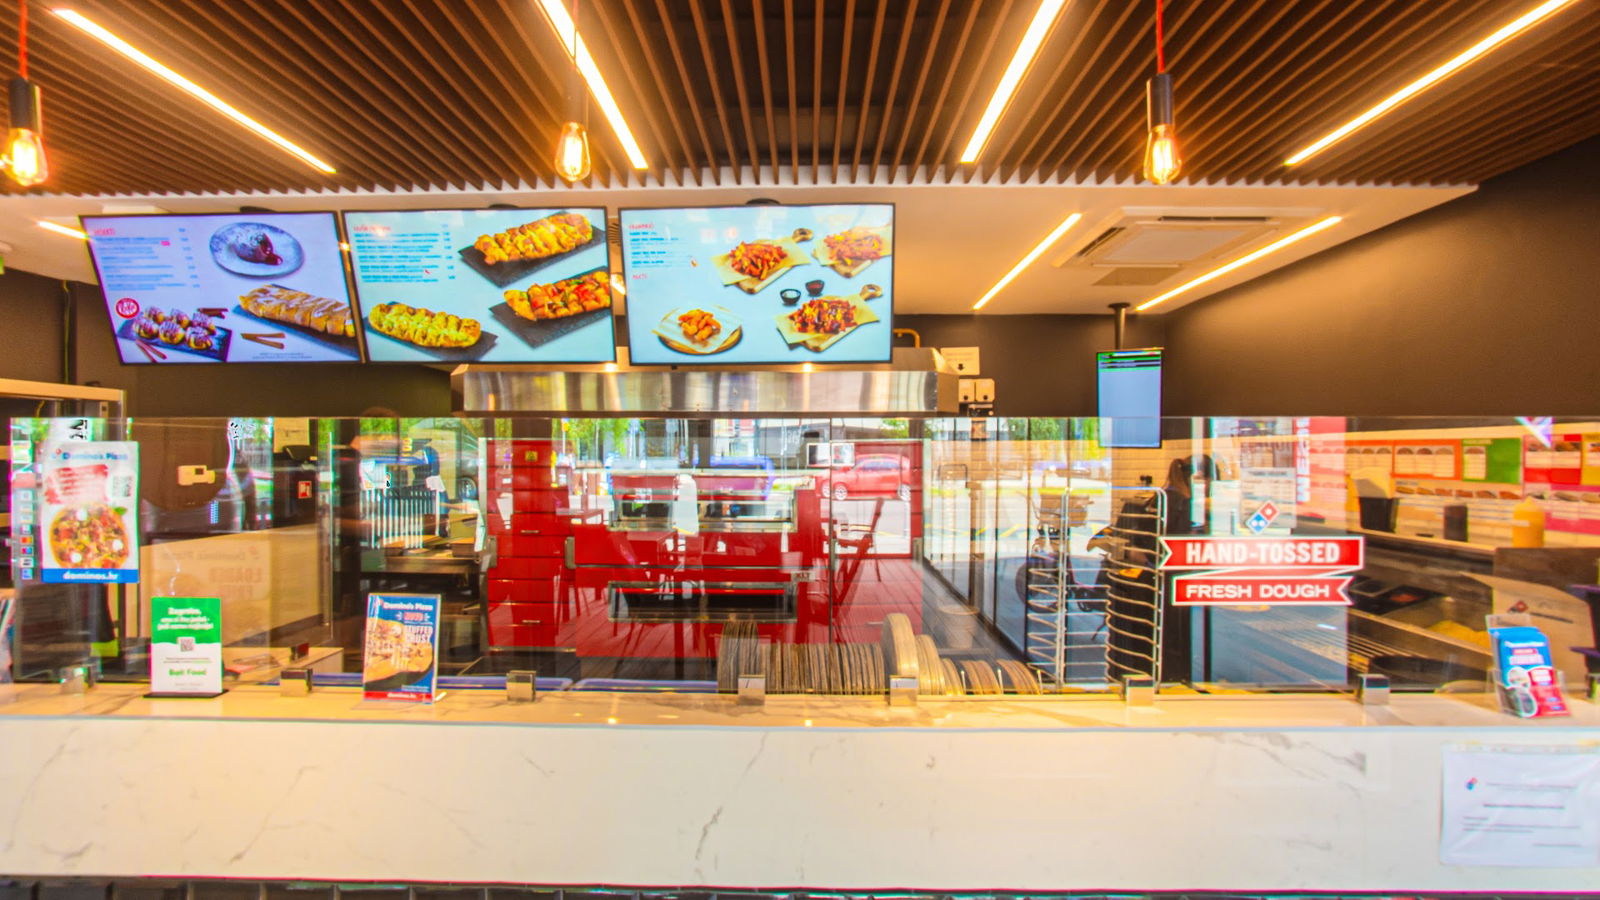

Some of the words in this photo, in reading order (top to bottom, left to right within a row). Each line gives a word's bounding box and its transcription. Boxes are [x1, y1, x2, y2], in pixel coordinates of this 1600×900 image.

[1186, 542, 1341, 564] HAND-TOSSED
[62, 570, 118, 580] dominos.hr
[1186, 584, 1252, 598] FRESH
[1259, 584, 1330, 598] DOUGH
